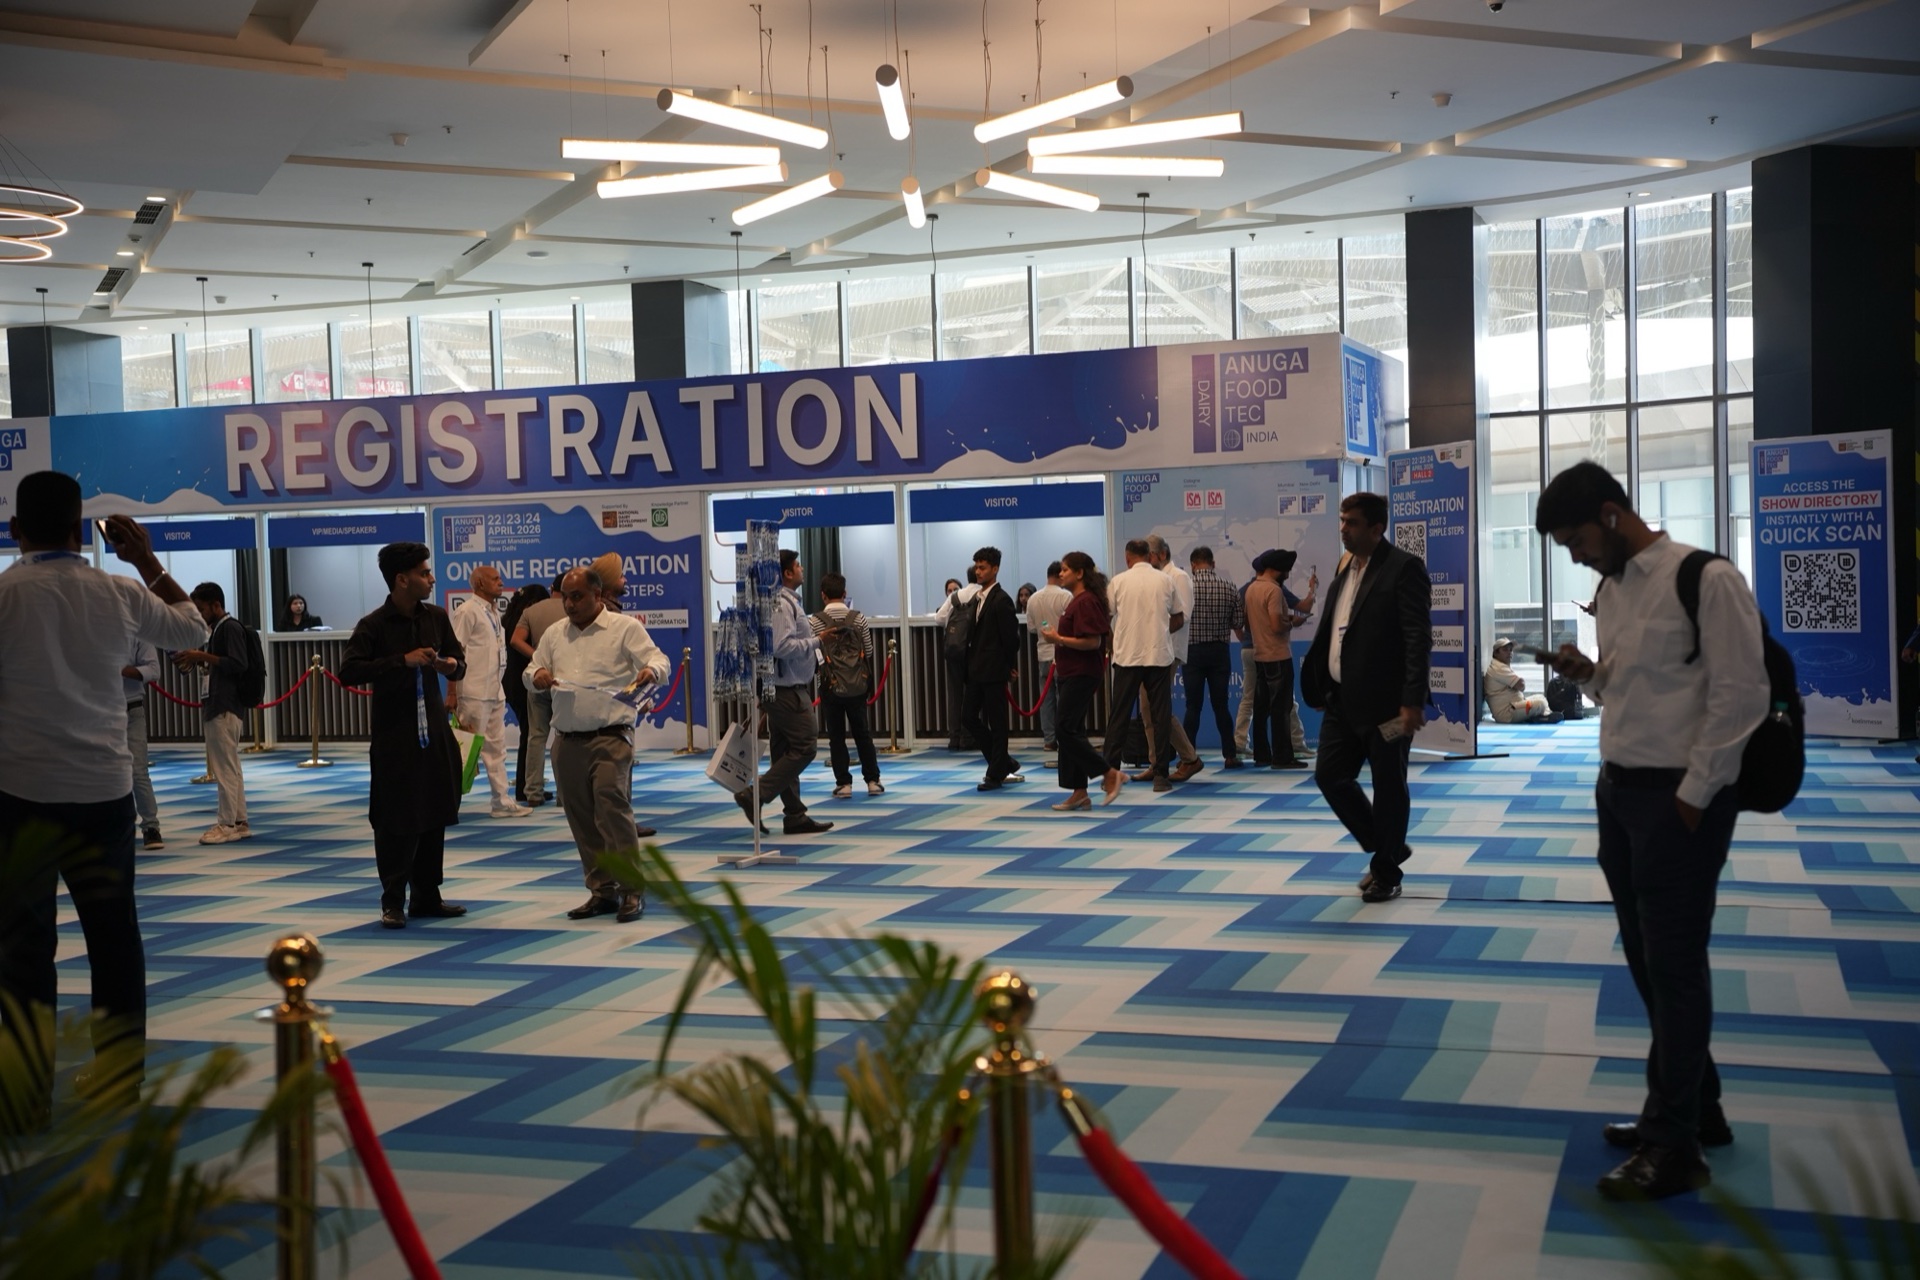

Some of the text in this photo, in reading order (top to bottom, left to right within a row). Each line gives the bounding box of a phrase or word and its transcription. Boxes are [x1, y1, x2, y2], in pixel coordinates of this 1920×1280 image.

[1224, 351, 1304, 375] ANUGA
[1225, 377, 1282, 400] FOOD
[1197, 379, 1211, 427] DAIRY
[1224, 404, 1261, 423] TEC
[224, 373, 919, 492] REGISTRATION
[1246, 431, 1278, 443] INDIA
[1125, 475, 1158, 483] ANUGA
[1413, 471, 1427, 479] HALL
[1125, 484, 1149, 492] FOOD
[1783, 479, 1855, 493] ACCESS THE
[1126, 494, 1140, 502] TEC
[1186, 492, 1201, 506] ISM
[1208, 491, 1223, 506] ISM
[1393, 491, 1416, 501] ONLINE
[984, 497, 1018, 507] VISITOR
[1393, 496, 1464, 517] REGISTRATION
[1762, 493, 1879, 511] SHOW DIRECTORY
[782, 507, 813, 517] VISITOR
[1429, 516, 1447, 526] JUST 3
[1766, 510, 1875, 526] INSTANTLY WITH A
[312, 525, 377, 536] VIP/MEDIA/SPEAKERS
[454, 526, 475, 534] FOOD
[488, 525, 541, 535] APRIL 2026
[1429, 526, 1465, 537] SIMPLE STEPS
[1760, 524, 1882, 545] QUICK SCAN
[164, 531, 191, 541] VISITOR
[1429, 573, 1445, 582] STEP
[623, 584, 664, 597] STEPS
[1435, 588, 1448, 597] CODE
[1449, 588, 1456, 596] TO
[1431, 671, 1444, 679] YOUR
[1431, 680, 1447, 689] BADGE
